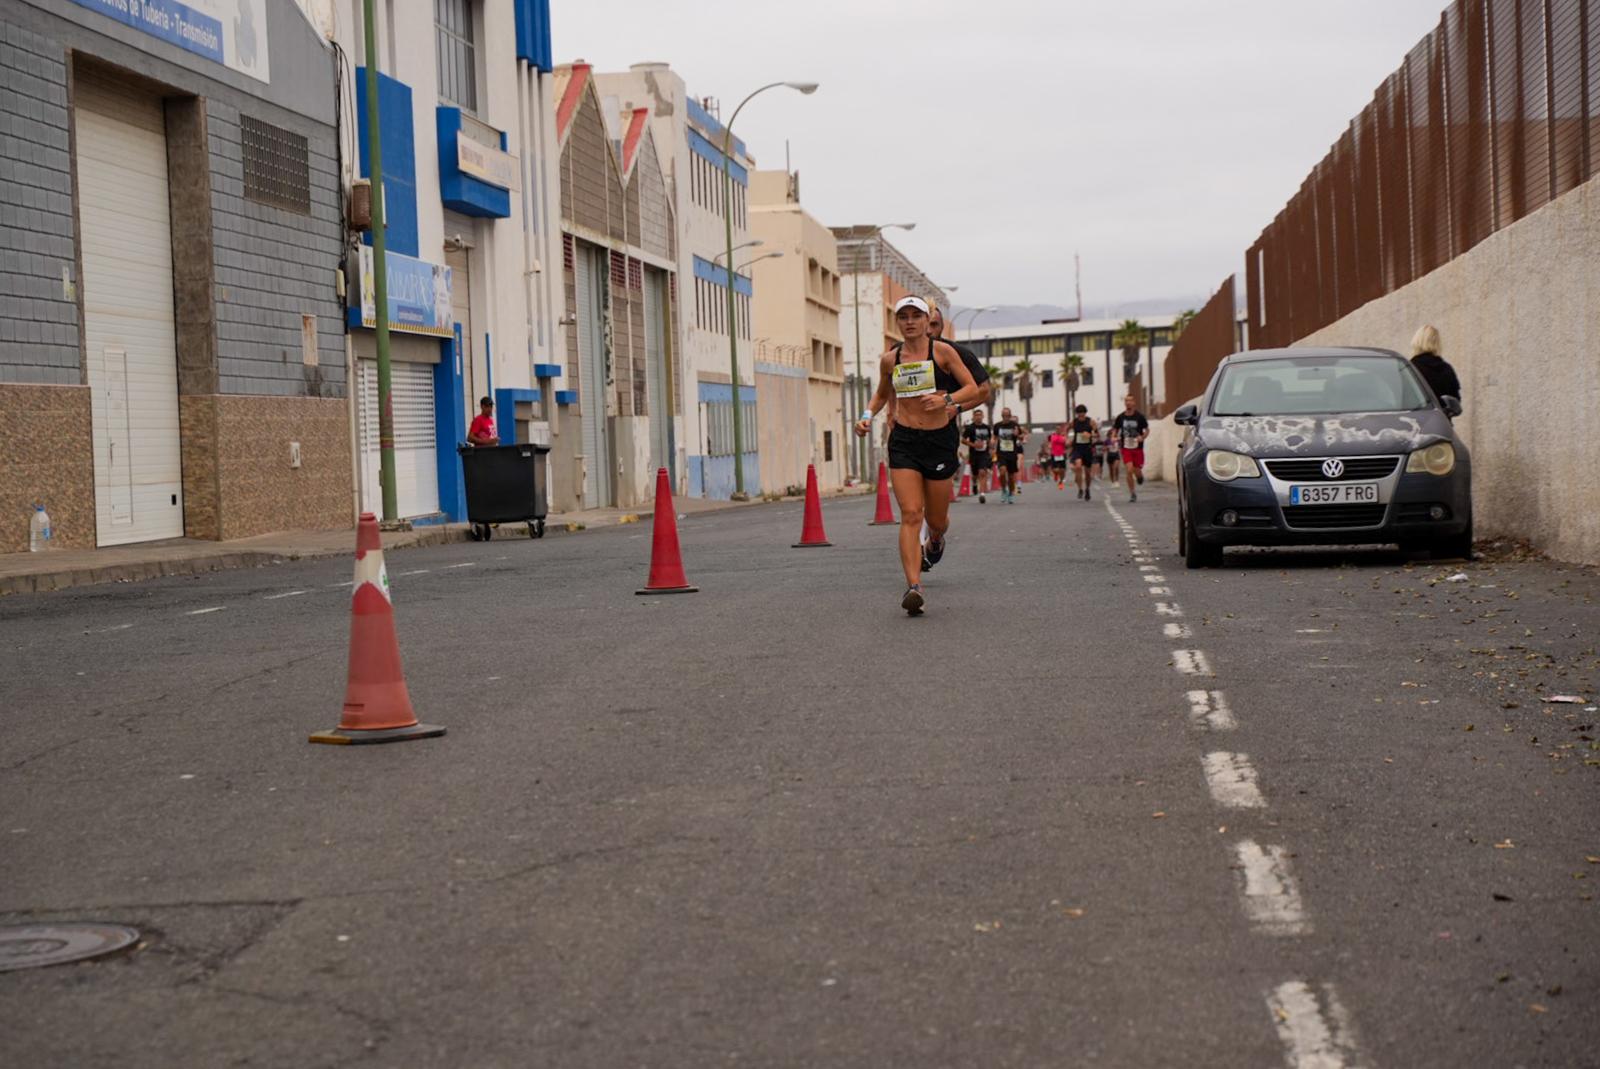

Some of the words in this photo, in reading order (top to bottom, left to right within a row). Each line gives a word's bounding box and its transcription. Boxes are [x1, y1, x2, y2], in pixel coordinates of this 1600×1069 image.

[907, 375, 918, 386] 41
[1302, 487, 1340, 502] 6357
[1345, 486, 1374, 501] FRG
